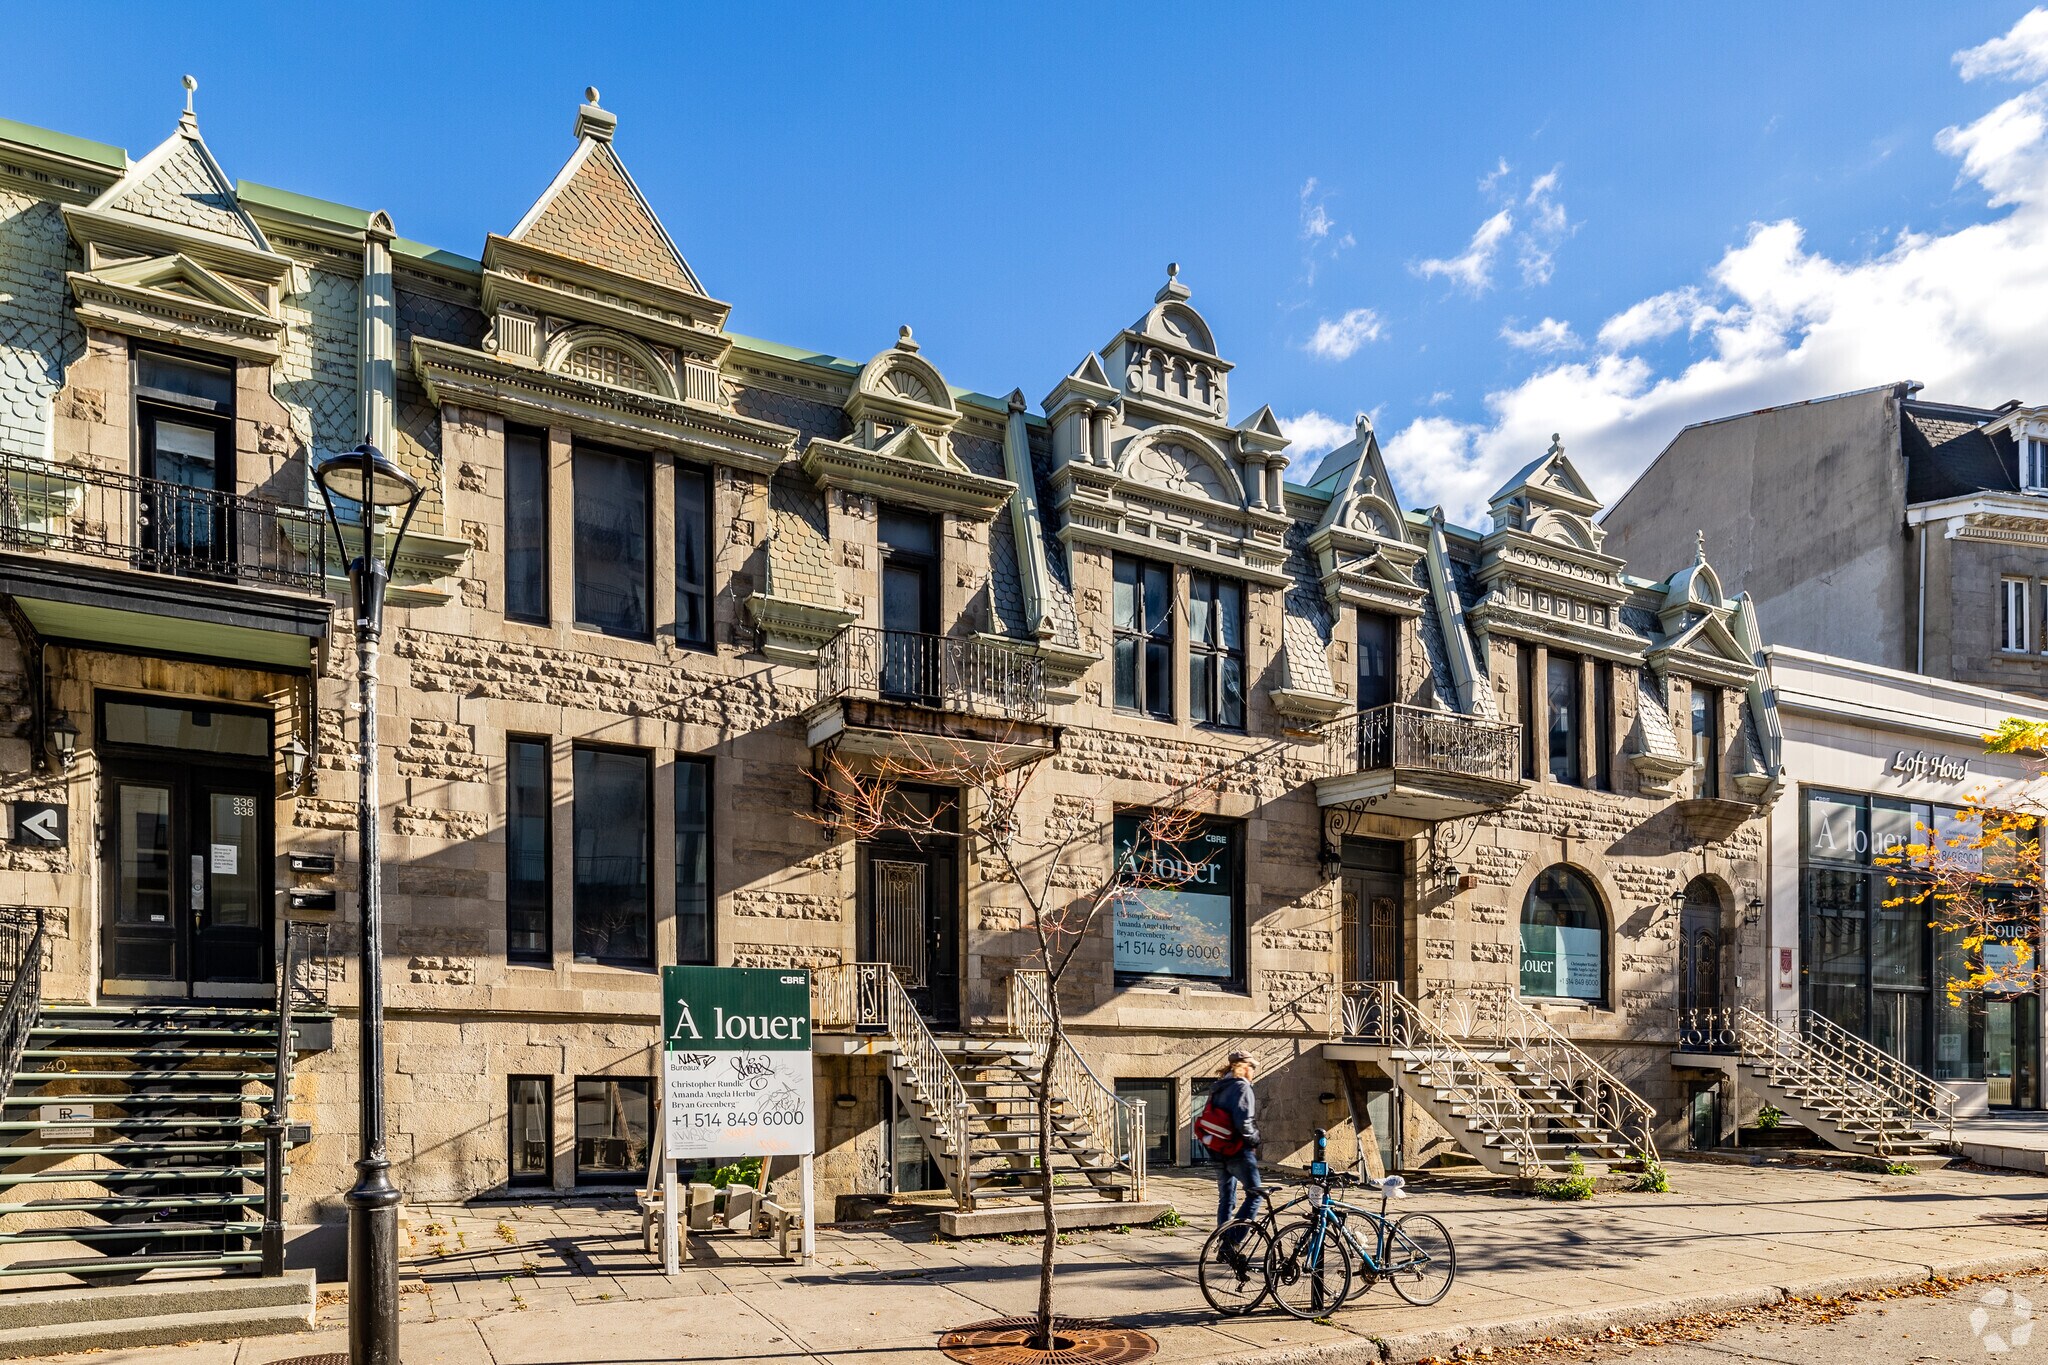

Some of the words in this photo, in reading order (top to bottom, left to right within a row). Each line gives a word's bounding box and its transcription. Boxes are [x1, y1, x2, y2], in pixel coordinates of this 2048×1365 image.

[1893, 751, 1928, 781] Loft
[1930, 755, 1971, 780] Hotel
[233, 797, 254, 807] 336
[233, 806, 254, 816] 338
[1815, 808, 1837, 850] À
[1846, 820, 1908, 857] louer
[1205, 834, 1227, 844] CBRE
[1116, 929, 1135, 938] Bryan
[1135, 930, 1166, 940] Greenberg
[1116, 940, 1129, 954] +1
[1133, 941, 1155, 955] 514
[1159, 942, 1183, 957] 849
[1187, 944, 1220, 959] 6000
[780, 976, 805, 985] CBRE
[669, 998, 703, 1040] À
[713, 1007, 806, 1040] louer
[670, 1063, 700, 1071] Bureaux
[671, 1080, 716, 1089] Christopher
[717, 1080, 744, 1088] Rundle
[705, 1091, 731, 1099] Angela
[671, 1101, 695, 1110] Bryan
[696, 1101, 736, 1109] Greenberg
[672, 1113, 689, 1128] +1
[694, 1112, 722, 1127] 514
[727, 1112, 758, 1126] 849
[763, 1111, 804, 1125] 6000
